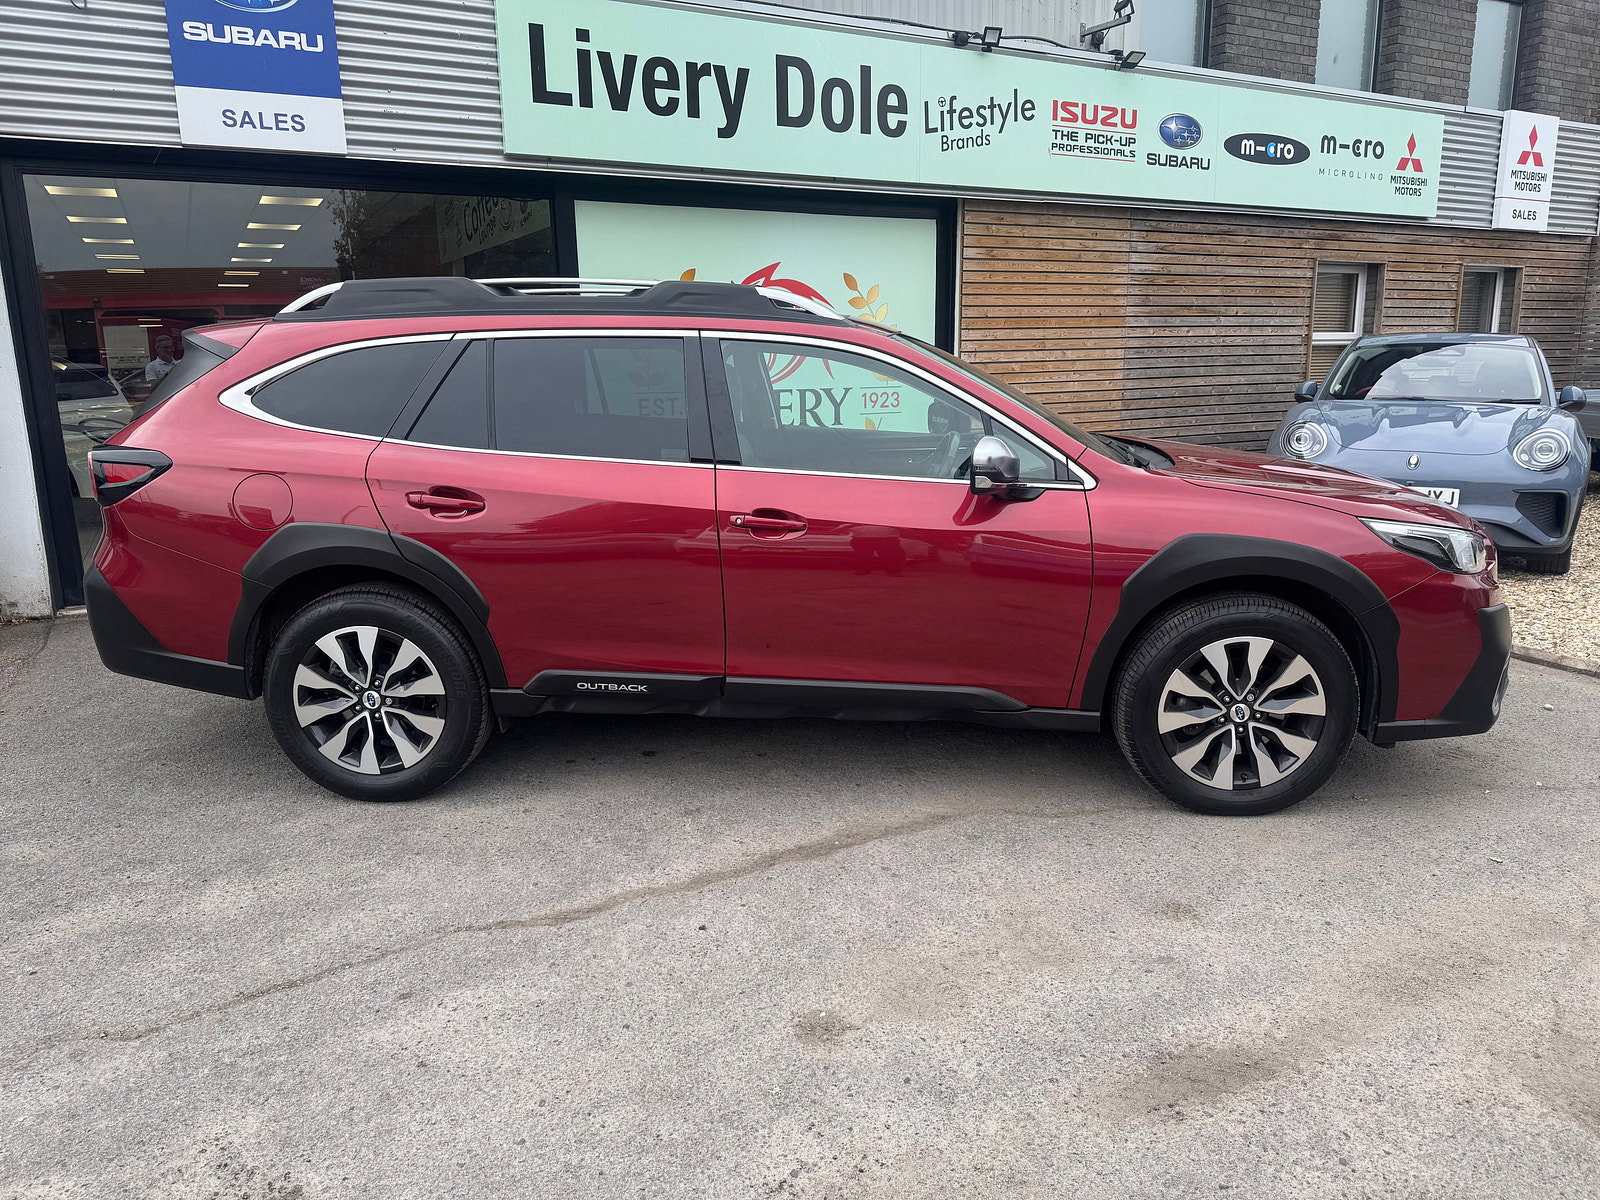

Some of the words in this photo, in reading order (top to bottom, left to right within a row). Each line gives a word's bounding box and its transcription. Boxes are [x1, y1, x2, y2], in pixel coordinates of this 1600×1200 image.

[182, 21, 324, 53] SUBARU
[528, 22, 750, 139] Livery
[775, 54, 909, 138] Dole
[924, 88, 1036, 134] Lifestyle
[1052, 100, 1138, 129] ISUZU
[221, 109, 306, 132] SALES
[941, 129, 991, 152] Brands
[1052, 129, 1080, 142] THE
[1084, 133, 1136, 147] PICK-UP
[1051, 142, 1136, 158] PROFESSIONALS
[1146, 152, 1210, 171] SUBARU
[1318, 167, 1384, 181] MICROLINO
[1390, 175, 1428, 187] MITSUBISHI
[1510, 169, 1548, 182] MITSUBISHI
[1394, 186, 1422, 197] MOTORS
[1514, 181, 1542, 193] MOTORS
[1511, 208, 1538, 221] SALES
[638, 397, 684, 417] EST.
[773, 387, 853, 428] ERY
[861, 391, 901, 409] 1923
[576, 682, 649, 693] OUTBACK
